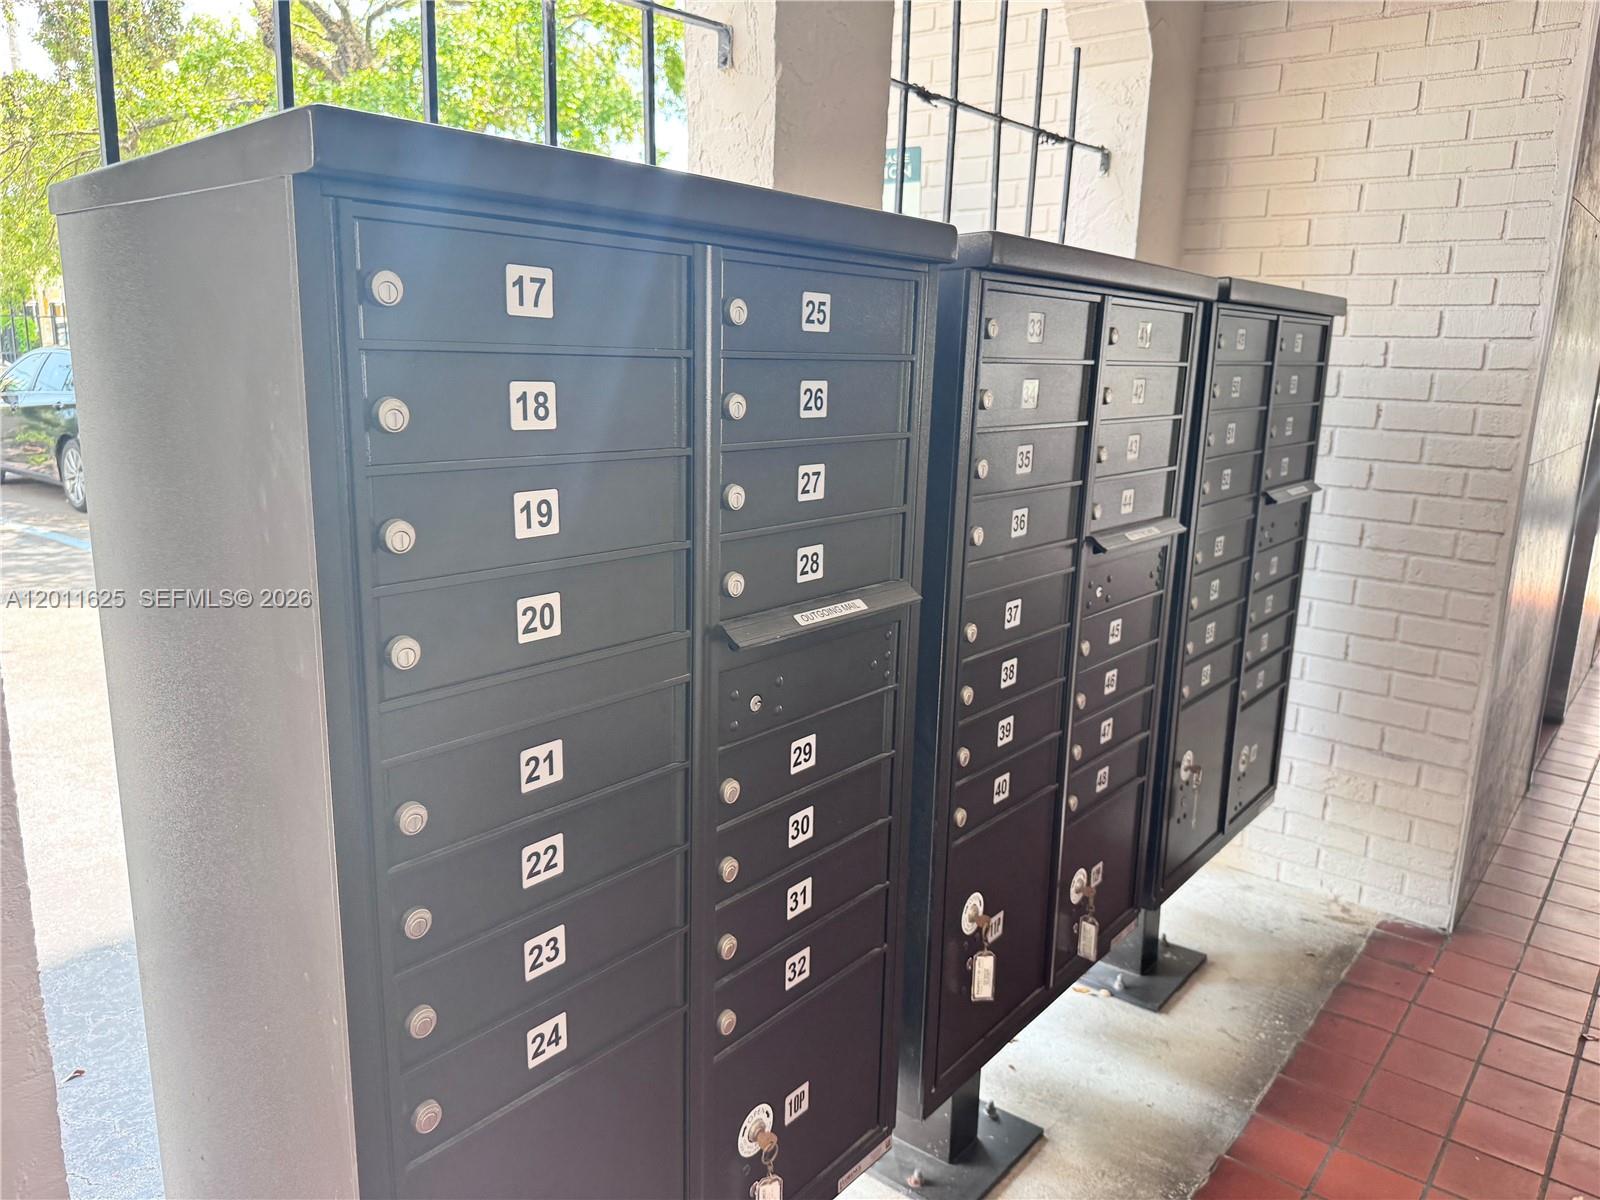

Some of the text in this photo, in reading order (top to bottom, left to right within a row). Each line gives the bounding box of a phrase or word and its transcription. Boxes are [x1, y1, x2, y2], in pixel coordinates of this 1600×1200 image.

[512, 275, 546, 308] 17
[805, 300, 826, 325] 25
[1028, 318, 1042, 337] 33
[516, 391, 549, 421] 18
[803, 388, 823, 411] 26
[1018, 450, 1030, 469] 35
[800, 471, 821, 495] 27
[520, 499, 552, 529] 19
[1013, 514, 1025, 532] 36
[800, 552, 819, 576] 28
[522, 603, 554, 635] 20
[800, 602, 860, 622] OUTGOING MAIL
[1007, 604, 1019, 623] 37
[1109, 624, 1120, 638] 45
[1002, 664, 1014, 683] 38
[1105, 674, 1115, 689] 46
[999, 722, 1011, 741] 39
[1100, 723, 1111, 738] 47
[525, 750, 554, 784] 21
[793, 742, 812, 768] 29
[995, 779, 1007, 796] 40
[791, 815, 809, 840] 30
[526, 844, 558, 880] 22
[790, 886, 806, 912] 31
[529, 937, 560, 973] 23
[788, 955, 806, 982] 32
[531, 1023, 562, 1060] 24
[789, 1090, 805, 1117] 10P
